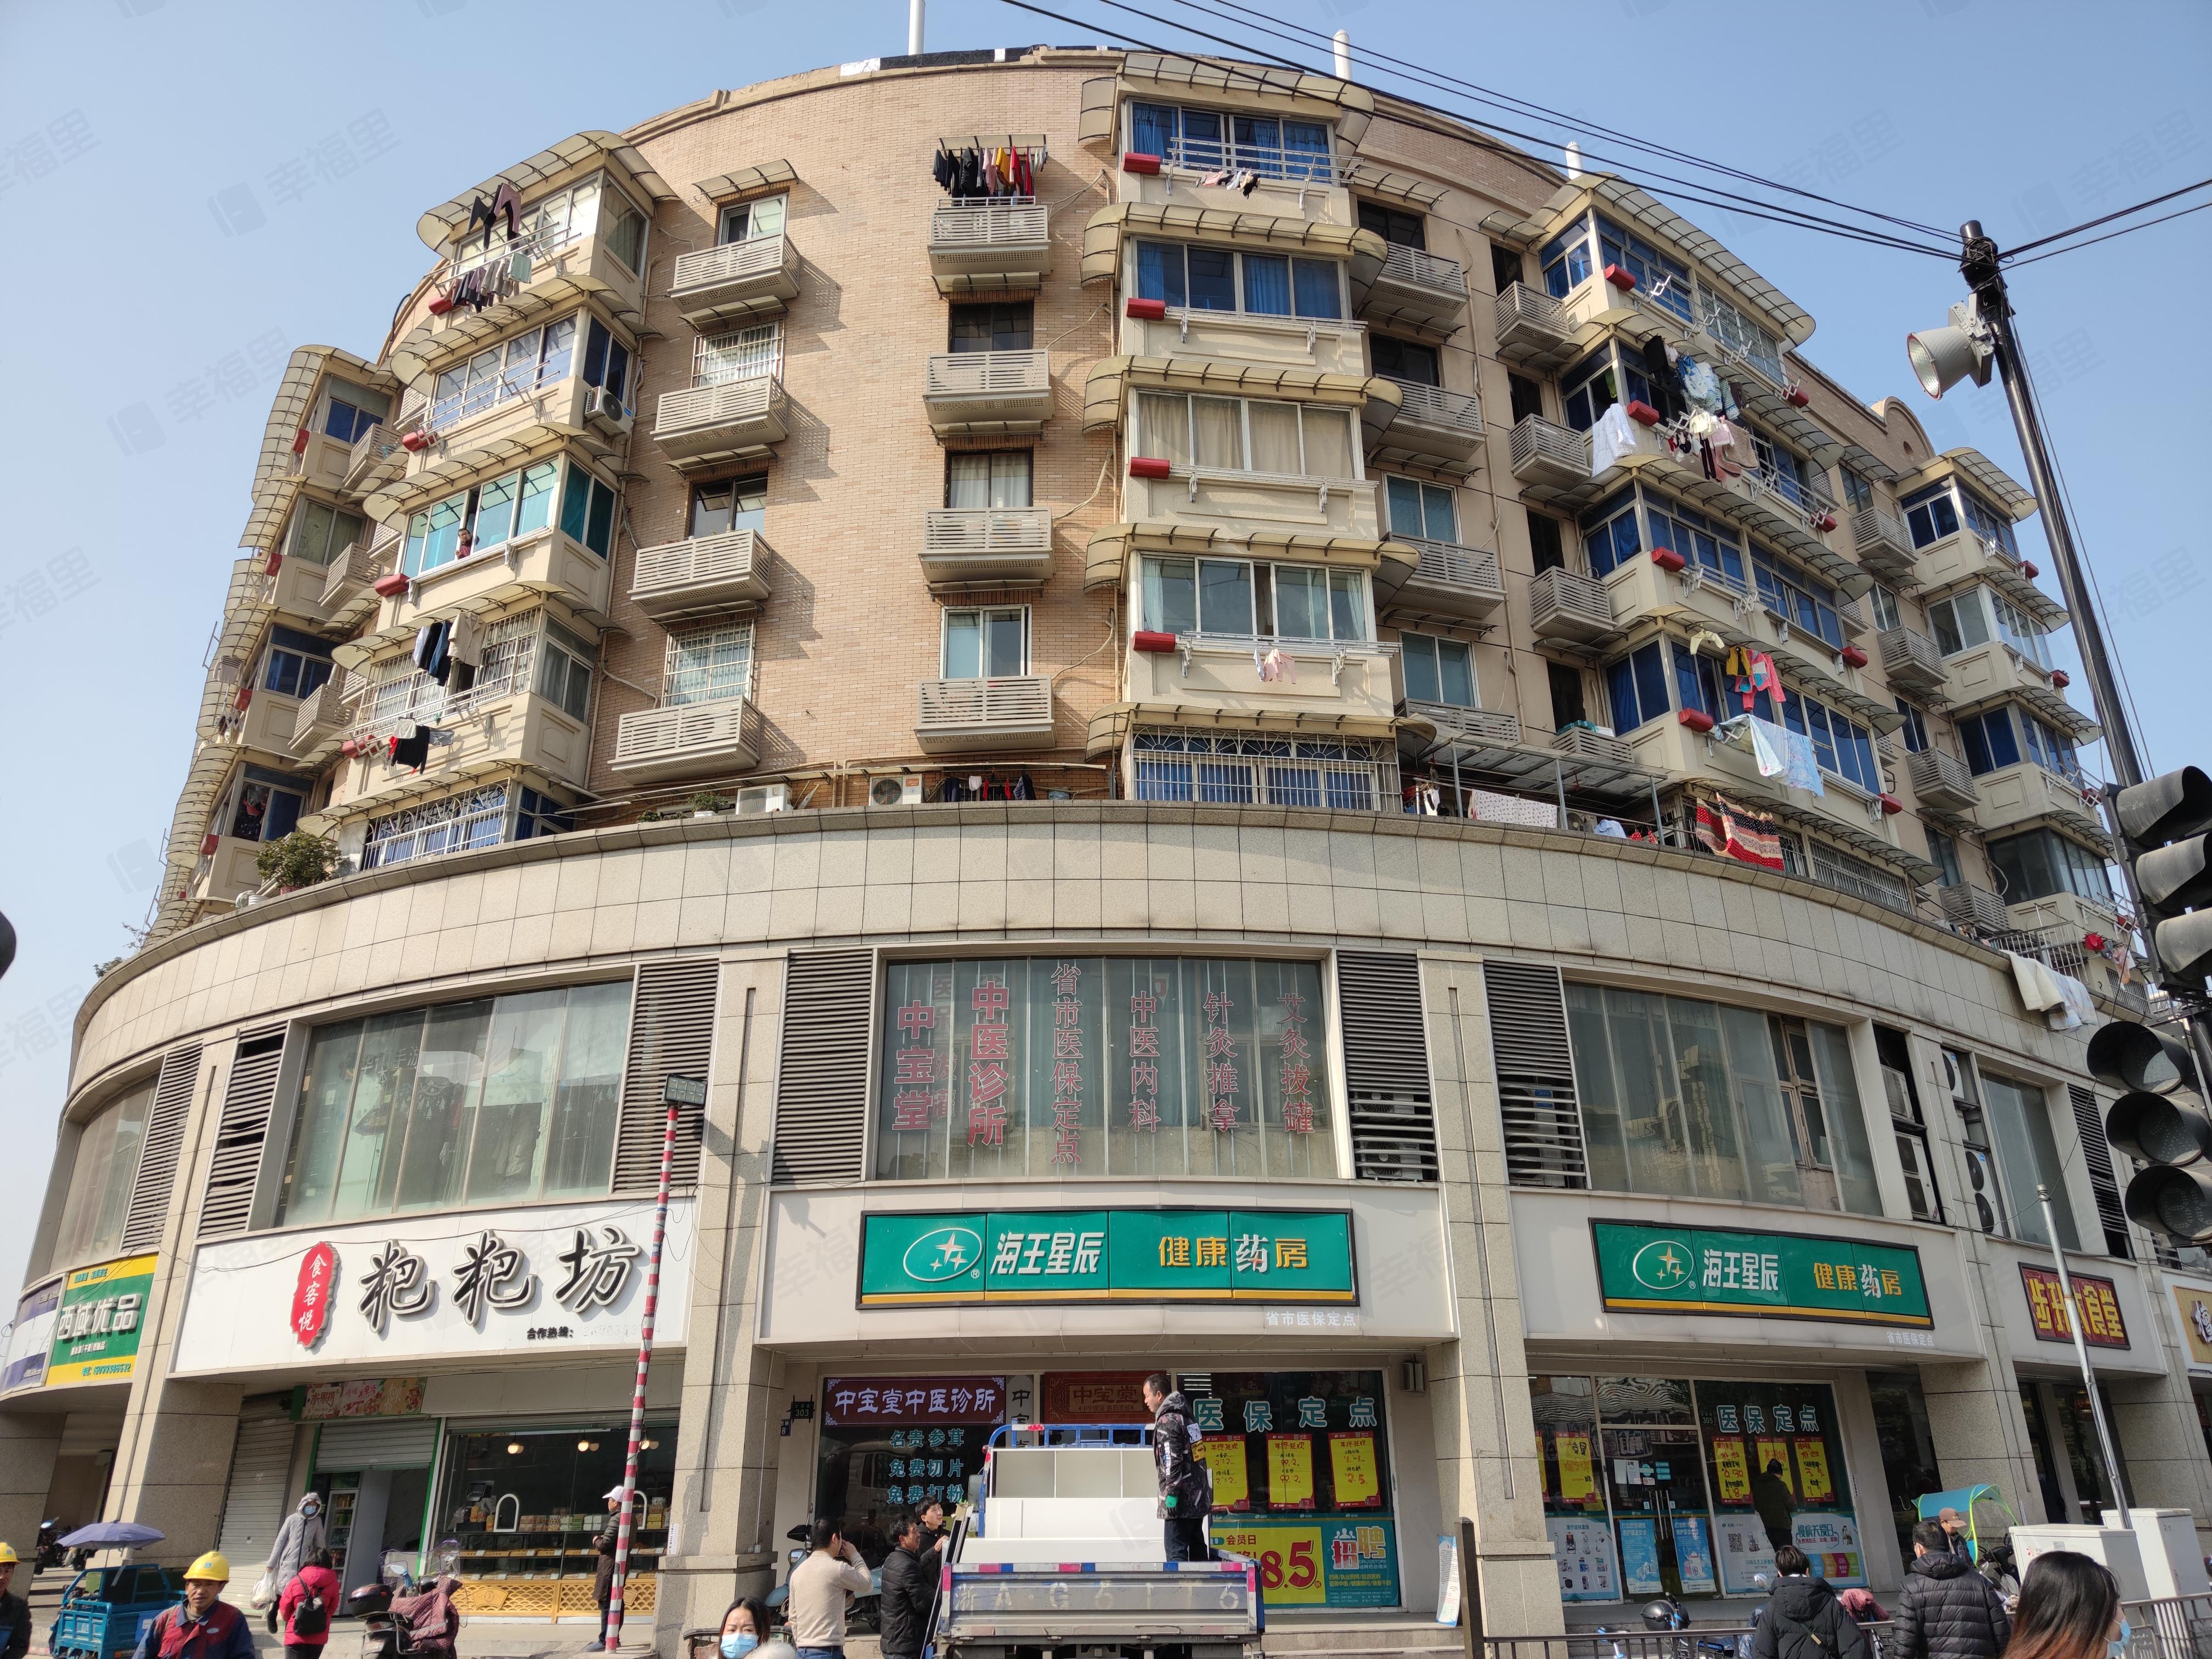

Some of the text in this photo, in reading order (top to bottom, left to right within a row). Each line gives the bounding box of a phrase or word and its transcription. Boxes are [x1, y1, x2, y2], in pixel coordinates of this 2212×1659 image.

[892, 1000, 934, 1130] 中宝堂
[968, 980, 1009, 1147] 中医诊所
[1050, 963, 1082, 1165] 省市医保定点
[1128, 990, 1161, 1133] 中医内科
[1203, 991, 1241, 1133] 针灸推拿
[1277, 992, 1315, 1134] 艾灸拔罐
[990, 1232, 1104, 1276] 海王星辰
[1159, 1233, 1308, 1273] 健康药房
[1702, 1249, 1779, 1291] 海王星辰
[357, 1224, 642, 1333] 粑粑坊
[1813, 1262, 1902, 1299] 健康药房
[57, 1294, 142, 1340] 西域优品
[1265, 1310, 1356, 1328] 省市医保定点
[1887, 1331, 1935, 1348] 省市医保定点
[834, 1387, 996, 1415] 中宝堂中医诊所
[1073, 1385, 1138, 1404] 中宝堂
[1194, 1396, 1378, 1432] 医保定点
[890, 1429, 964, 1448] 名贵参茸
[1717, 1404, 1819, 1434] 医保定点
[889, 1459, 964, 1478] 免费切片
[887, 1485, 964, 1505] 免费打粉
[1226, 1534, 1256, 1545] 会员日
[1331, 1526, 1386, 1570] 招聘
[1798, 1523, 1834, 1537] 慢病关爱日
[1260, 1540, 1318, 1589] 8.5
